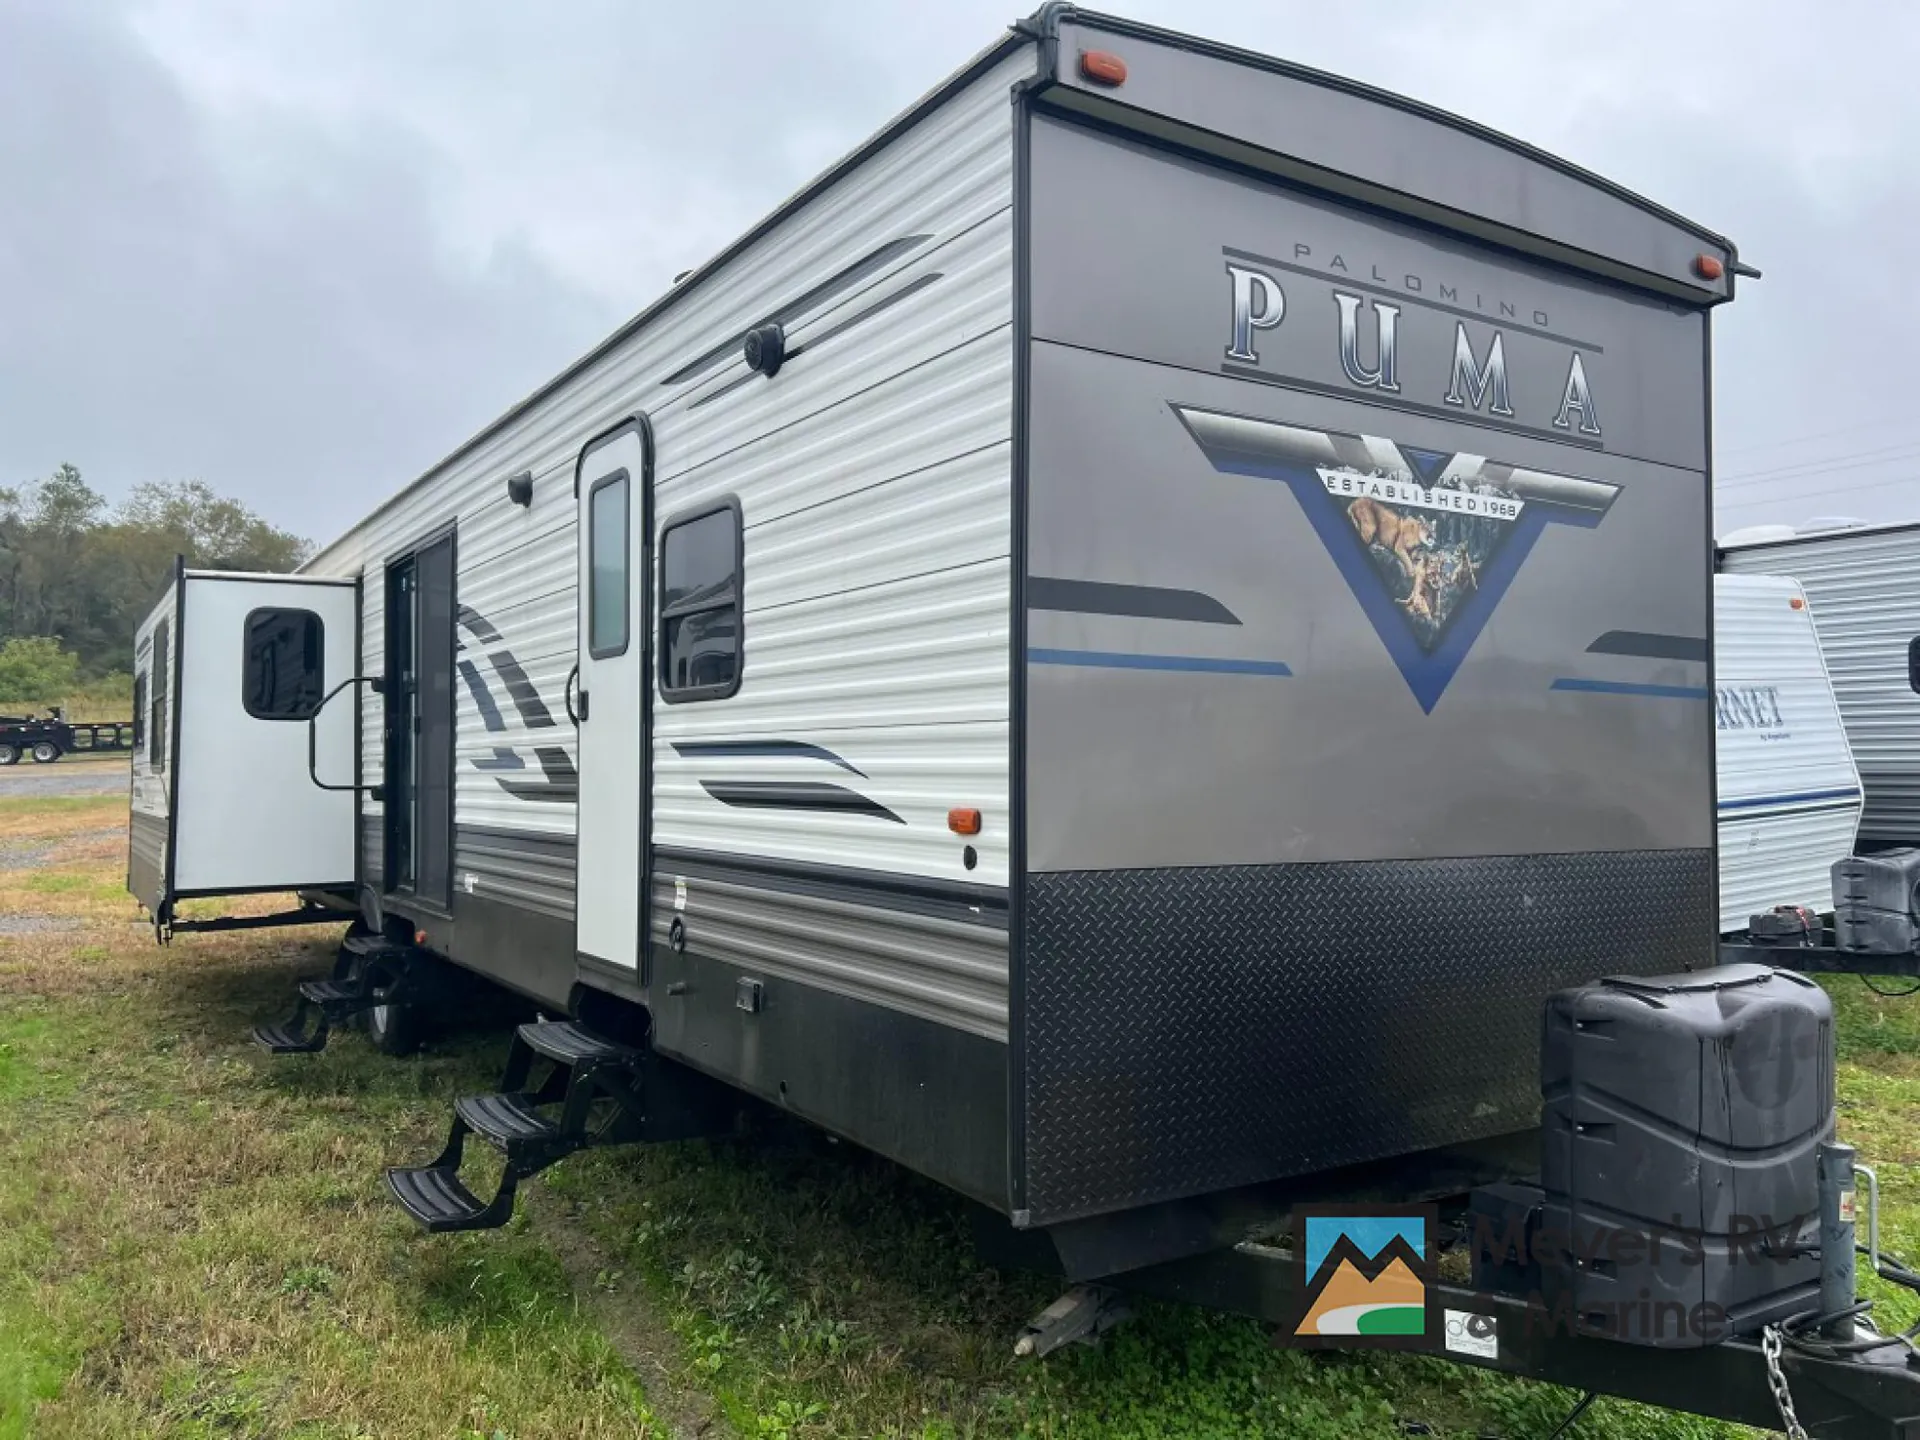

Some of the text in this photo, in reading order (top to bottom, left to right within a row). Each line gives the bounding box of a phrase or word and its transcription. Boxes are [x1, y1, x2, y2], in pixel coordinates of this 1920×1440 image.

[1294, 243, 1549, 327] PALOMINO
[1225, 260, 1602, 435] PUMA
[1326, 475, 1476, 511] ESTABLISHED
